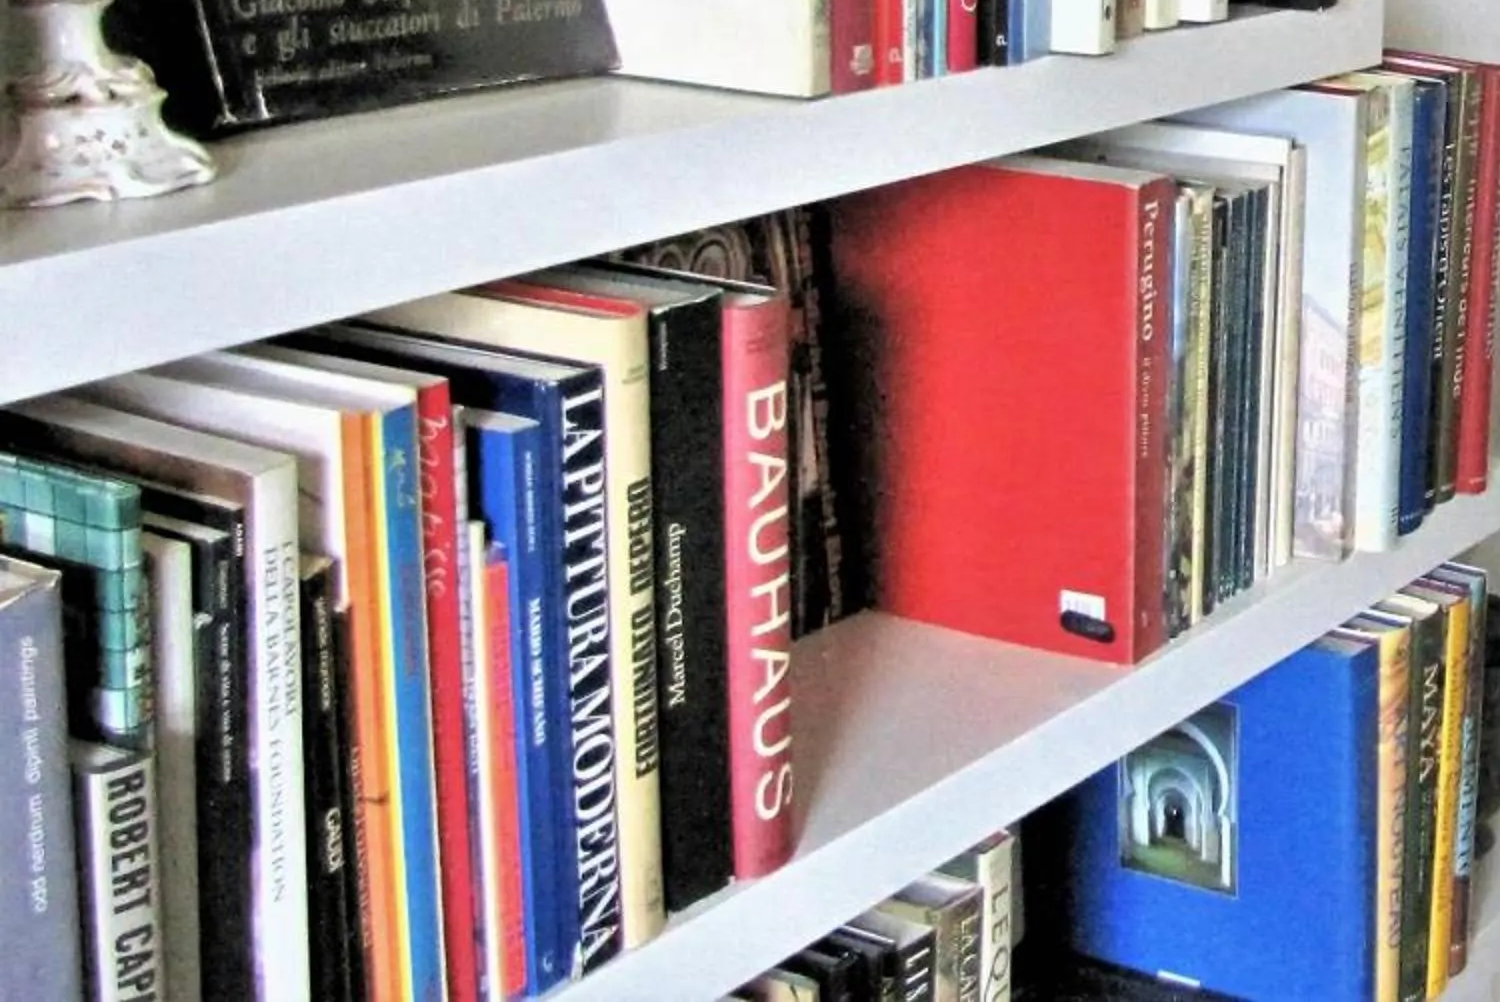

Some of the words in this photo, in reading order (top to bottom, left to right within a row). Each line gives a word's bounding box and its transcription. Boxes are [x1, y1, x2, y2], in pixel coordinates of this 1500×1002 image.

[243, 32, 258, 55] e
[277, 16, 311, 62] gli
[456, 0, 481, 29] di
[1140, 200, 1158, 342] Perugino
[562, 385, 603, 462] LA
[563, 462, 610, 689] PITTURA
[665, 522, 687, 633] Duchamp
[746, 380, 793, 821] BAUHAUS
[20, 635, 38, 721] paintings
[668, 634, 685, 708] Marcel
[1418, 664, 1441, 784] MAYA
[28, 792, 46, 873] nerdrum
[107, 768, 153, 915] ROBERT
[571, 686, 620, 968] MODERNA
[32, 874, 48, 915] odd
